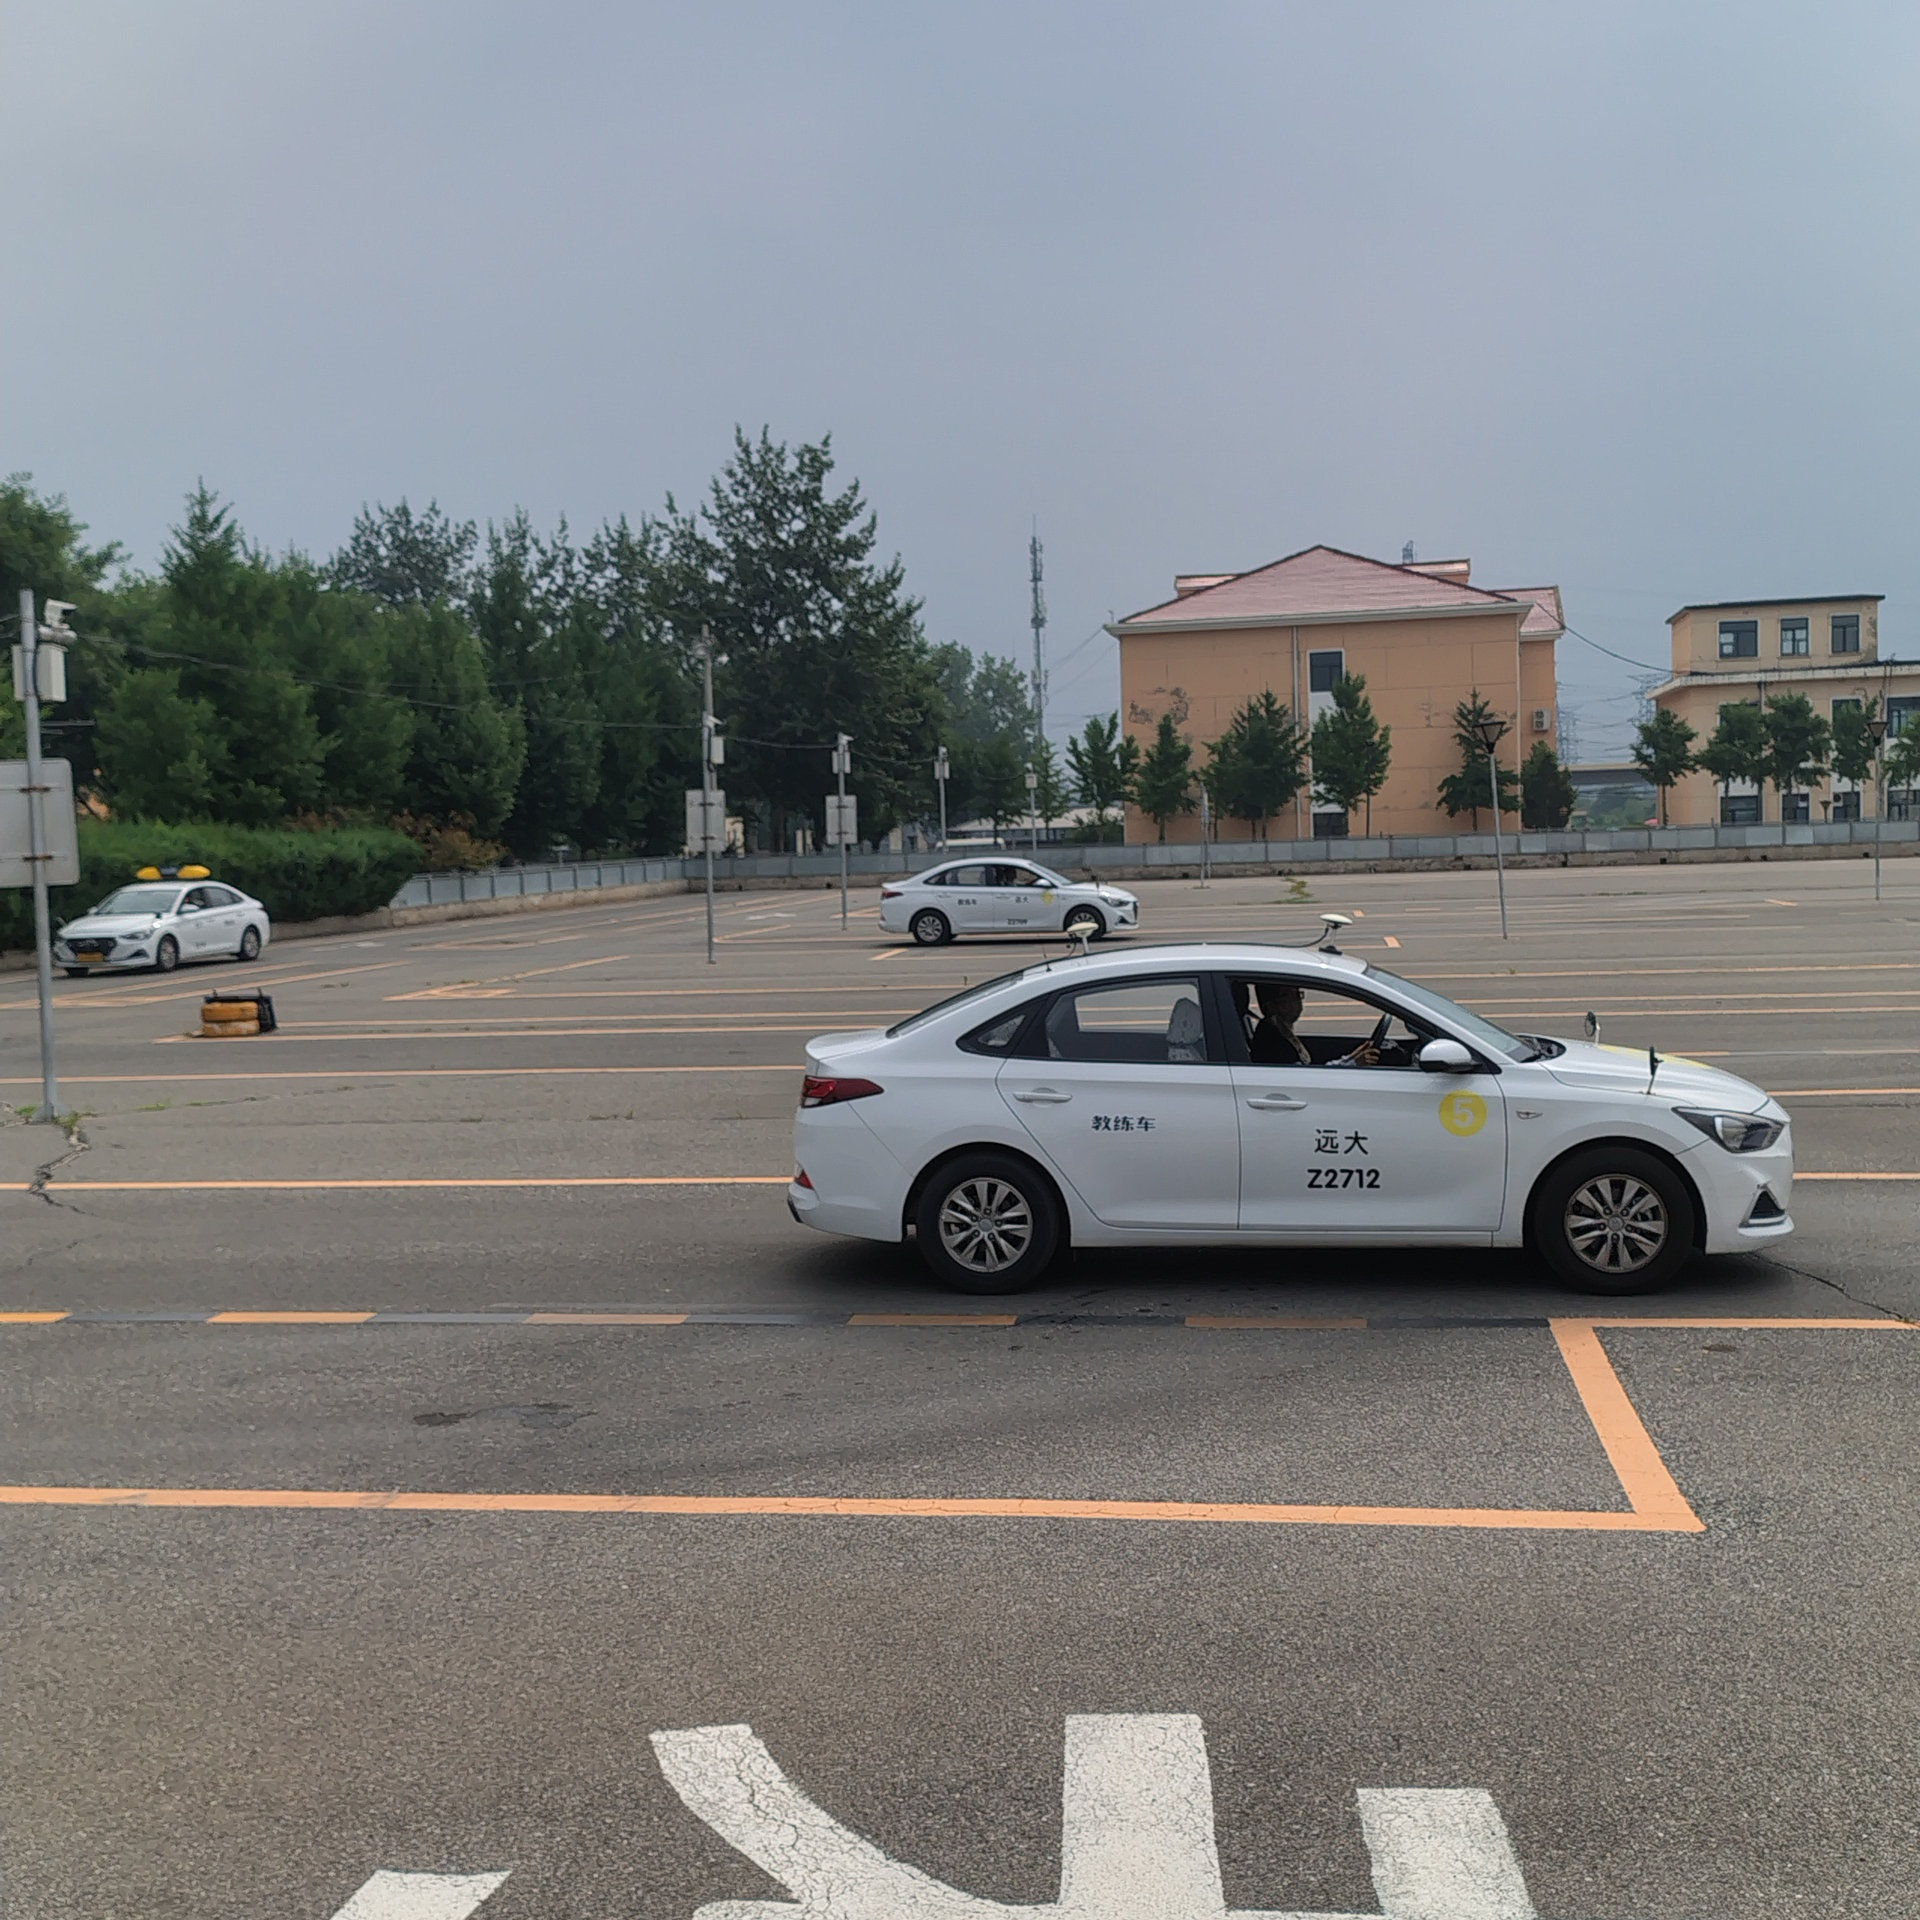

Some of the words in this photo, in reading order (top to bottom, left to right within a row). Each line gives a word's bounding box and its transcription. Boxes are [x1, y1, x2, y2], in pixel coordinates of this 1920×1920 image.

[1092, 1115, 1156, 1132] 教练车
[1453, 1097, 1474, 1128] 5
[1314, 1129, 1369, 1156] 远大
[1307, 1169, 1380, 1189] Z2712
